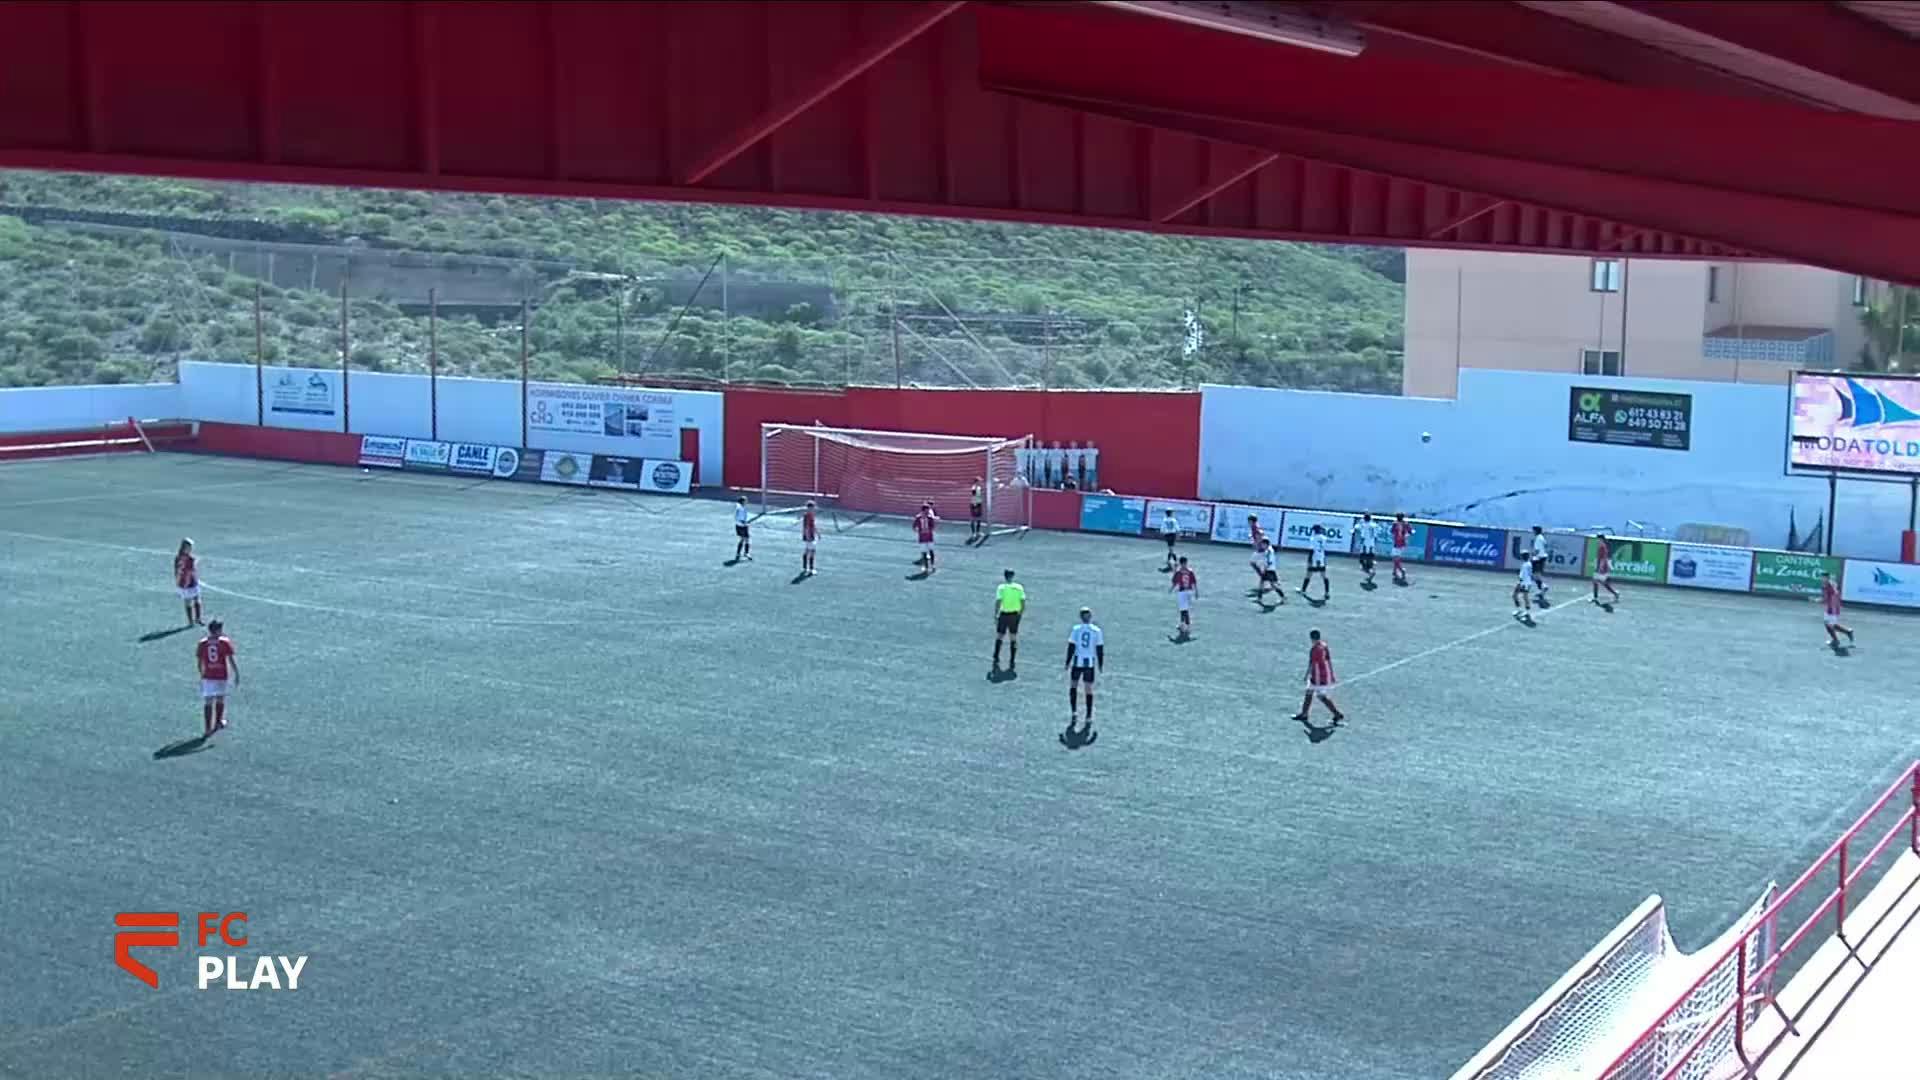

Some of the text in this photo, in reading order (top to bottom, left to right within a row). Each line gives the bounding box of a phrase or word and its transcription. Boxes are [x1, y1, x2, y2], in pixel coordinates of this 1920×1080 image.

[1574, 412, 1606, 424] ALFA
[457, 445, 489, 460] CANLE
[1080, 631, 1091, 649] 9
